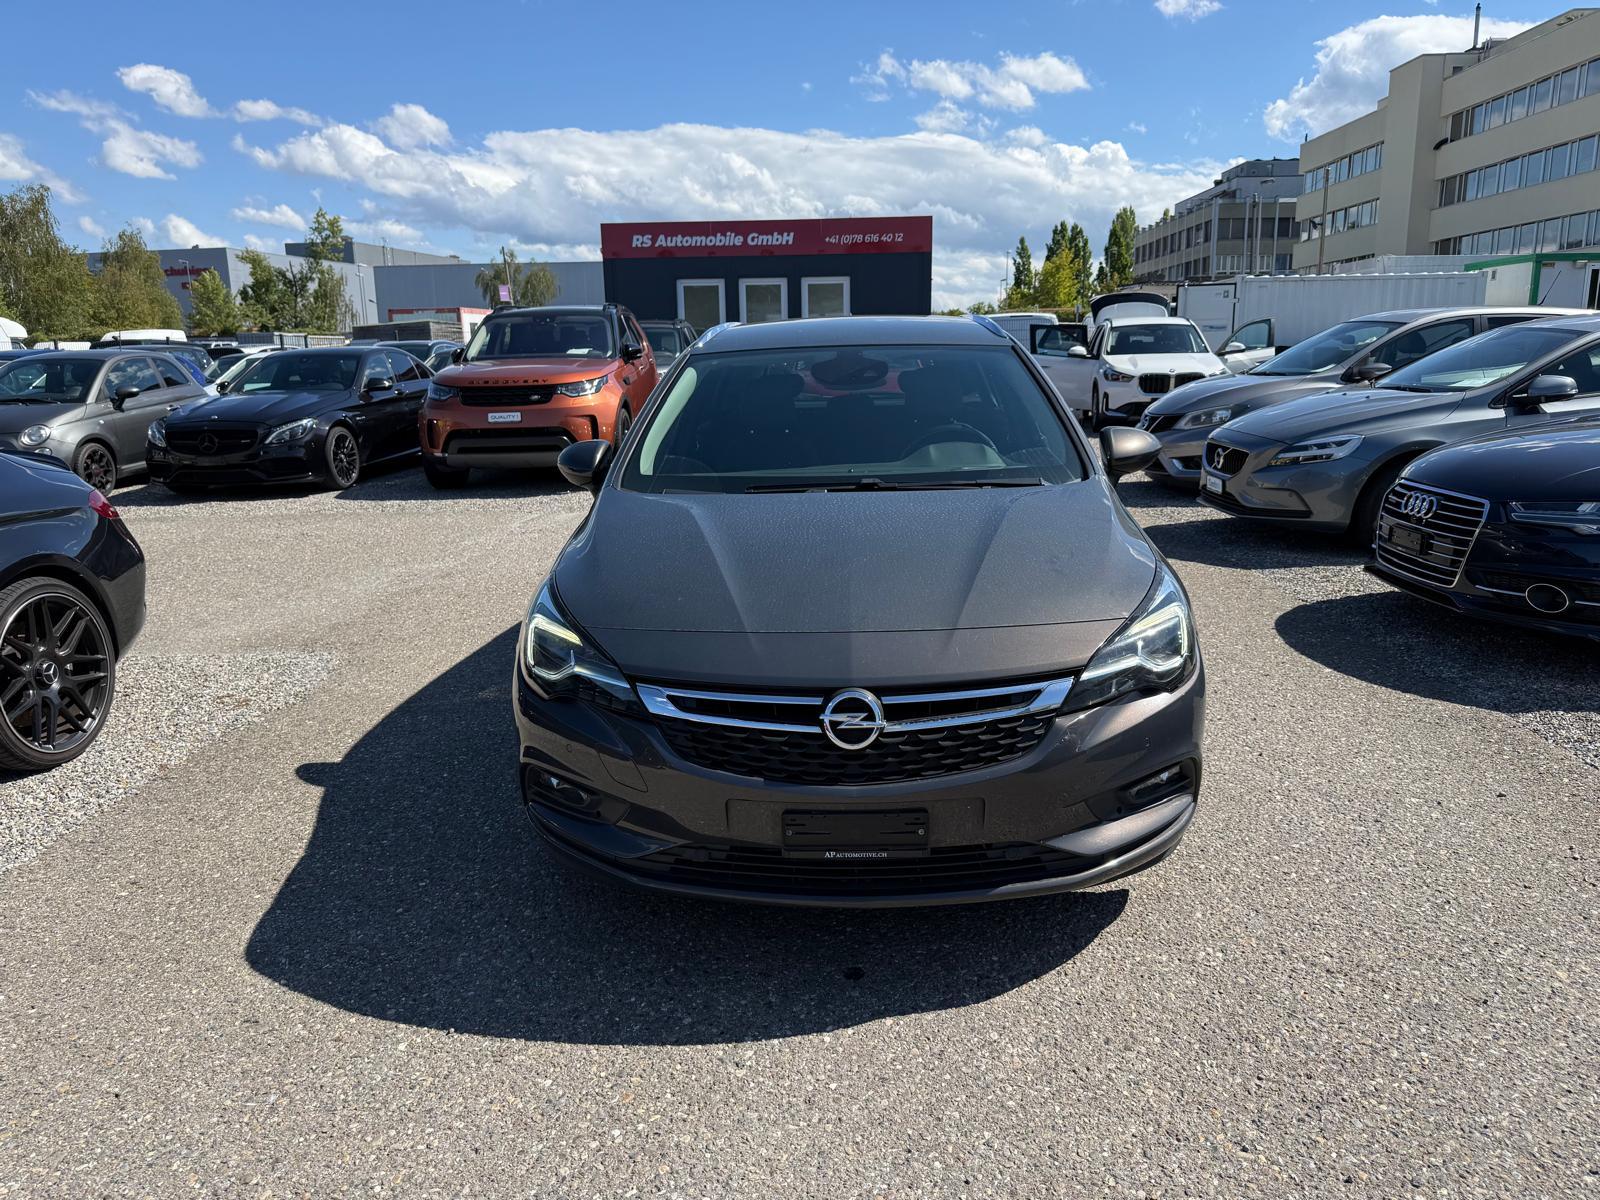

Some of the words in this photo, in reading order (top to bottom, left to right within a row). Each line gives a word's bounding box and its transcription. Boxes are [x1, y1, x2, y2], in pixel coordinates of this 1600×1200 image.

[631, 234, 652, 248] RS
[655, 232, 743, 247] Automobile
[747, 232, 794, 246] GmbH
[825, 235, 839, 244] +41
[840, 234, 863, 245] (0)78
[864, 233, 879, 243] 616
[881, 233, 893, 242] 40
[895, 232, 904, 242] 12
